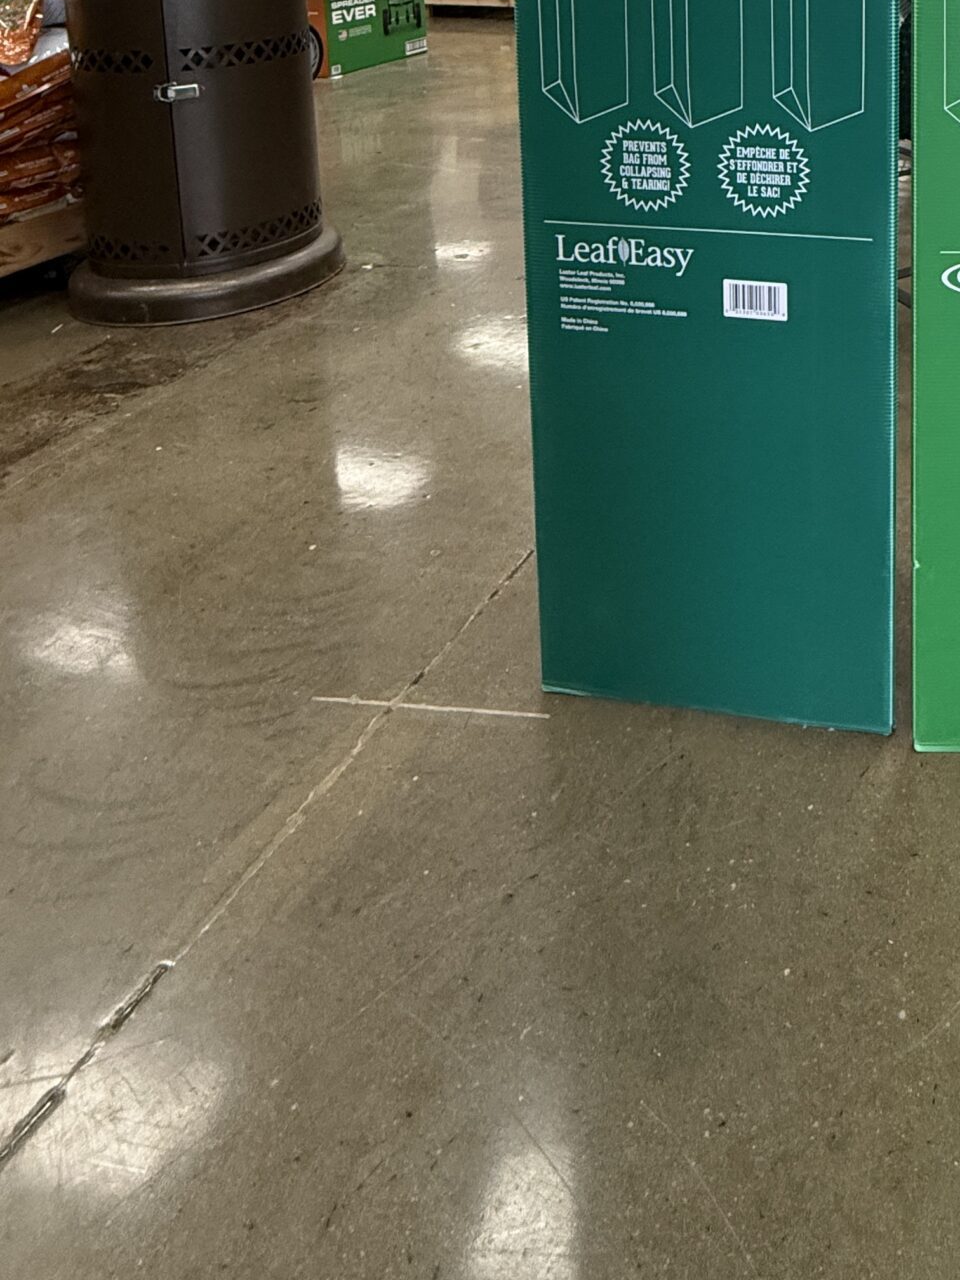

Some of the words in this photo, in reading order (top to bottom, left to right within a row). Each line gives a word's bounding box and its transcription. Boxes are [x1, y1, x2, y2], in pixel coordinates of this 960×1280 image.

[331, 4, 377, 25] EVER
[622, 140, 667, 152] PREVENTS
[622, 152, 640, 164] BAG
[642, 153, 667, 165] FROM
[779, 148, 790, 160] DE
[619, 166, 671, 178] COLLAPSING
[786, 161, 798, 173] ET
[621, 177, 628, 189] &
[630, 178, 670, 191] TEARING!
[736, 171, 748, 184] DE
[747, 185, 758, 197] LE
[760, 186, 780, 198] SAC!
